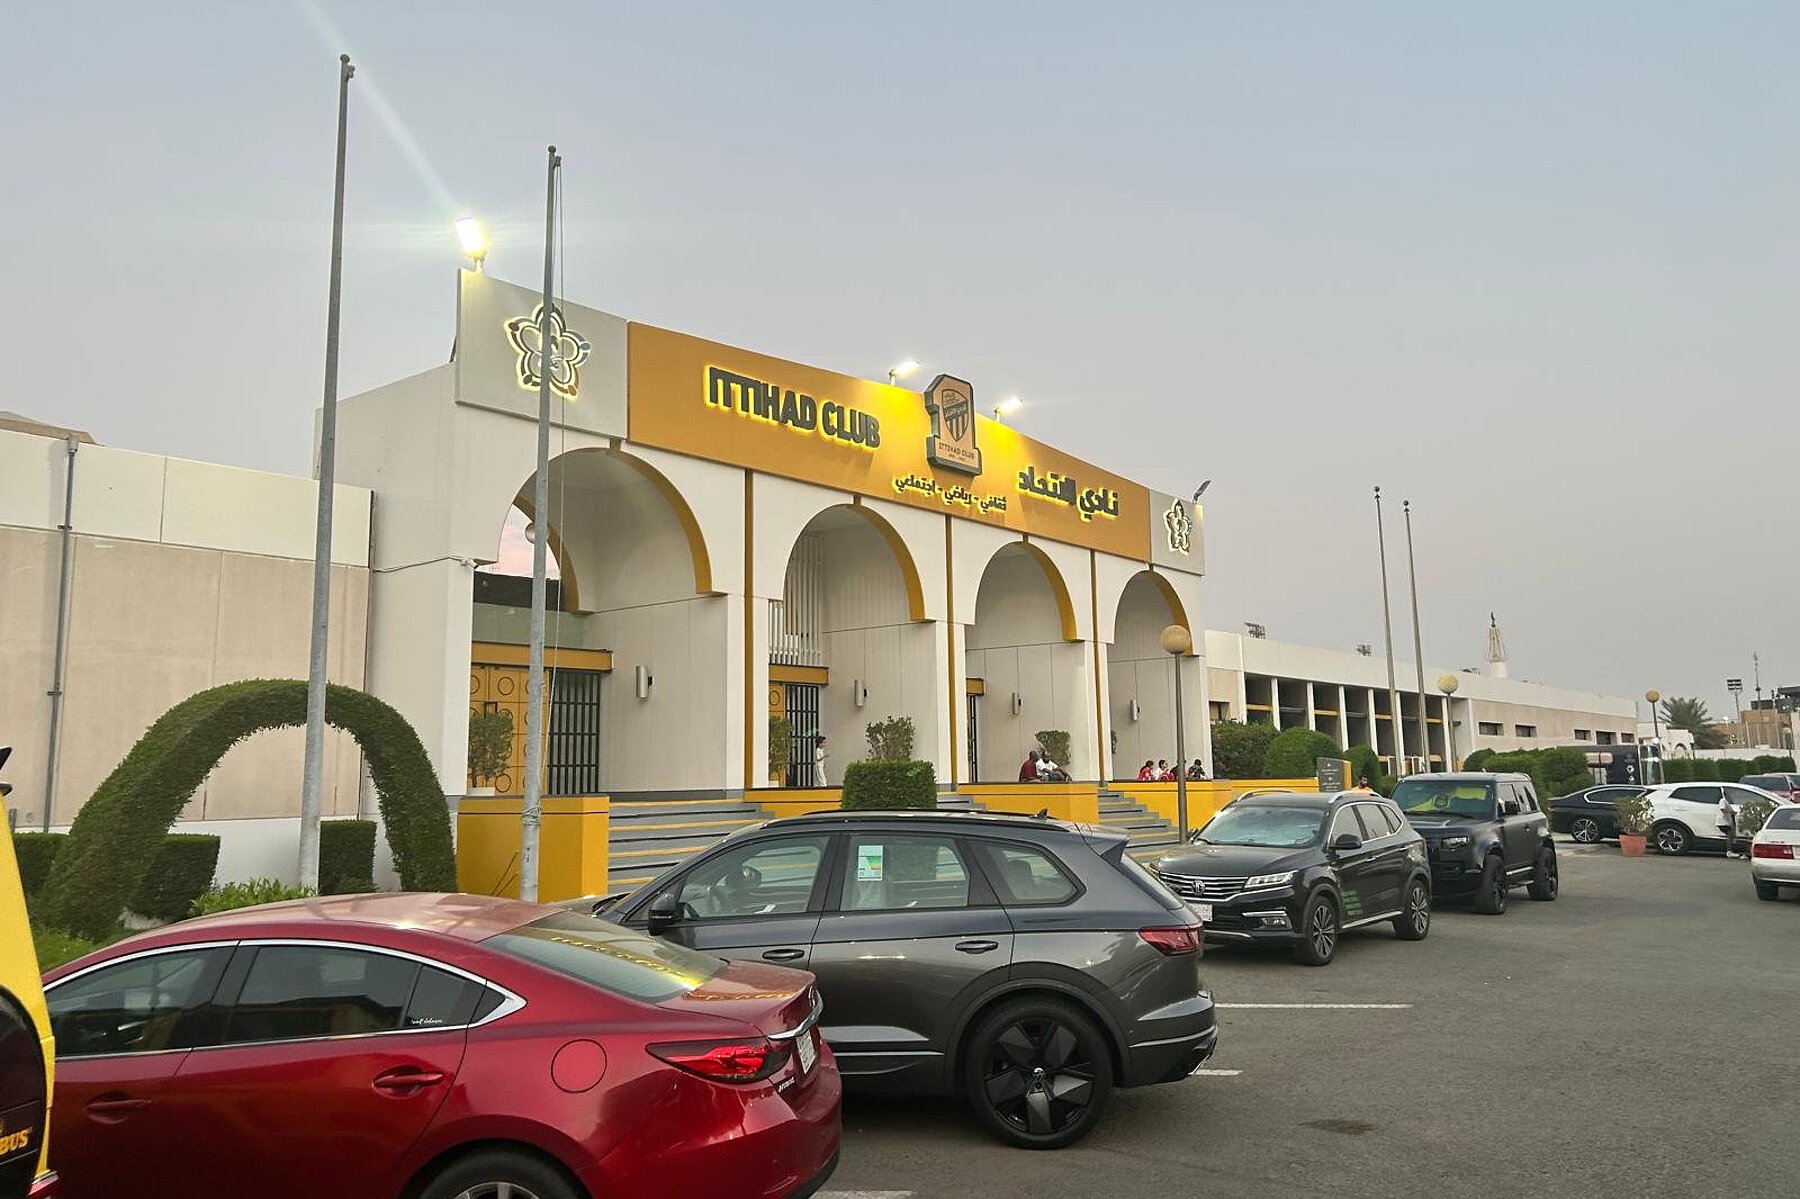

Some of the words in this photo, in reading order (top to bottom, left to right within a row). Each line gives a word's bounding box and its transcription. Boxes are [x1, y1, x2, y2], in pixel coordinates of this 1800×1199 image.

[708, 366, 818, 431] ITTIHAD
[821, 401, 881, 448] CLUB
[895, 474, 936, 496] اجتماعي
[944, 486, 972, 505] رياضي
[980, 496, 1007, 513] ثقافي
[1079, 488, 1119, 520] نادي
